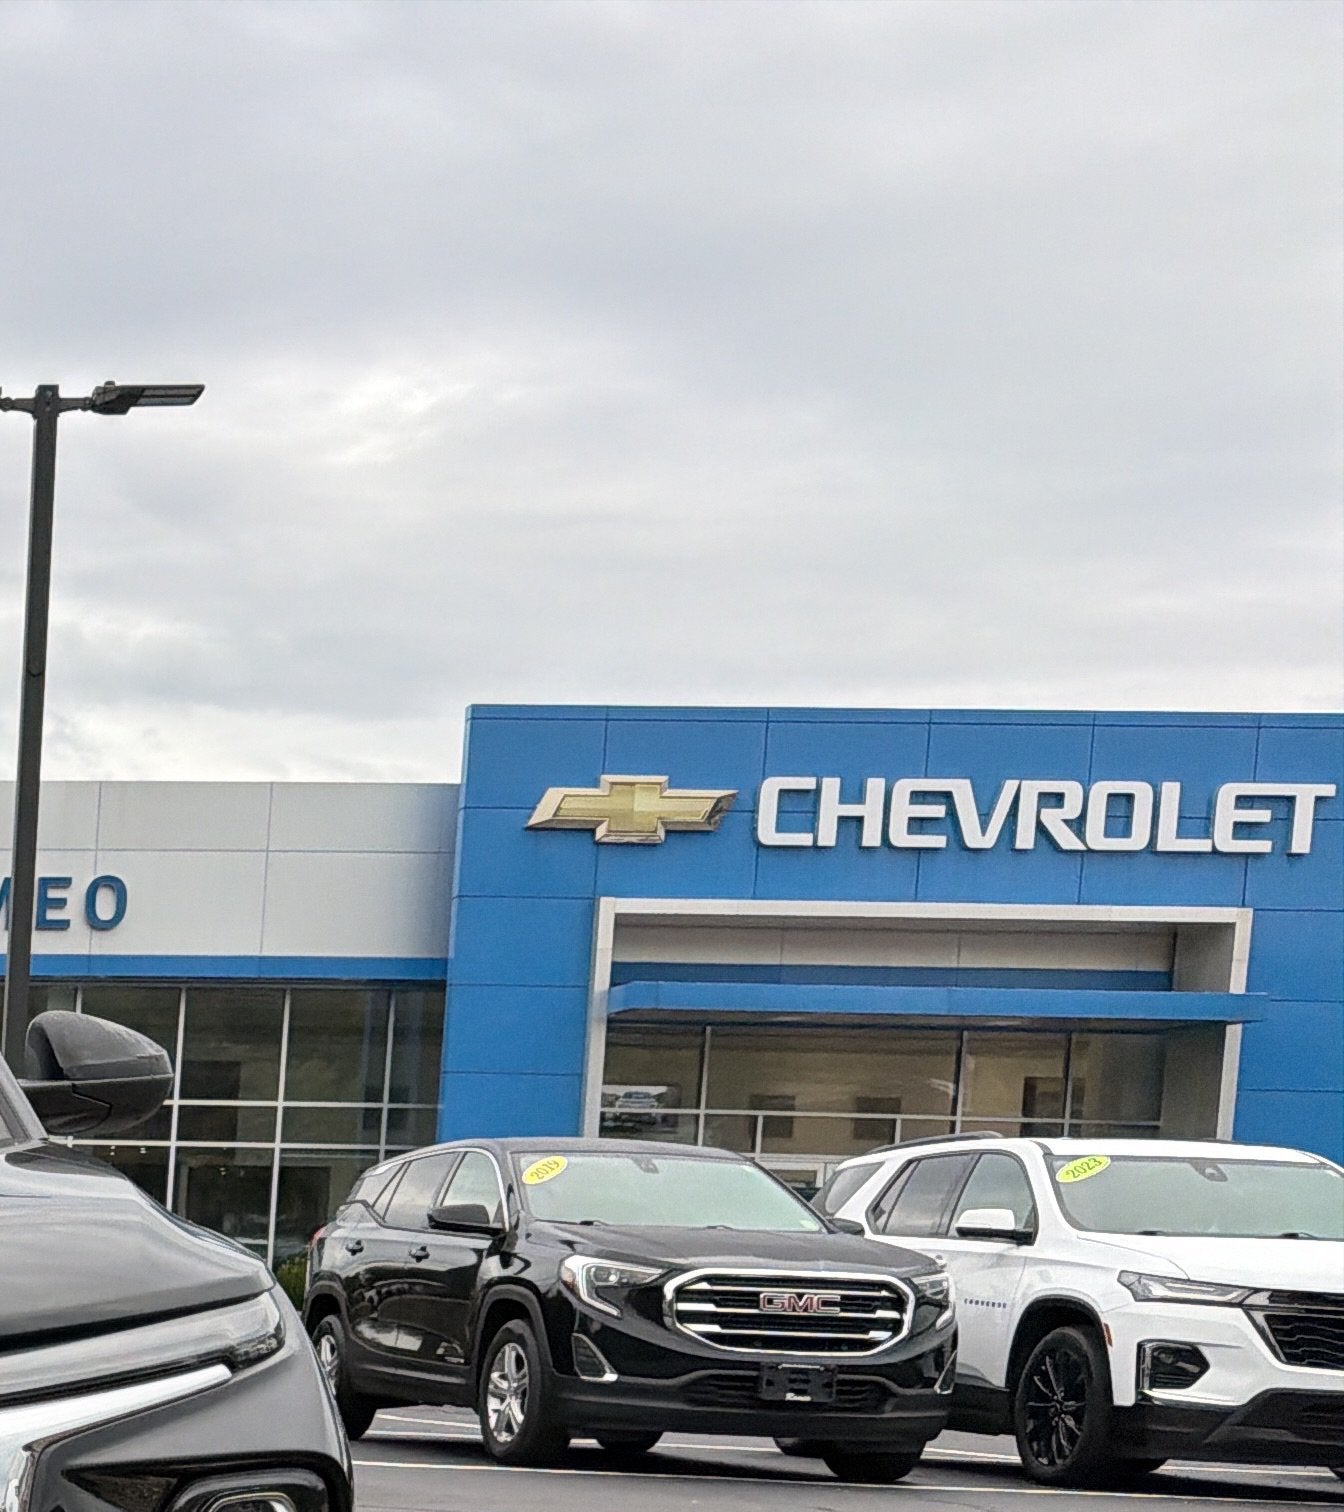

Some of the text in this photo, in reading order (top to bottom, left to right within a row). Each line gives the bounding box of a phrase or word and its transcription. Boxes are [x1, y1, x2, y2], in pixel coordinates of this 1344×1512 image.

[756, 776, 1337, 855] CHEVROLET
[530, 1160, 560, 1180] 2019
[1065, 1157, 1103, 1178] 2023
[760, 1292, 841, 1314] GMC
